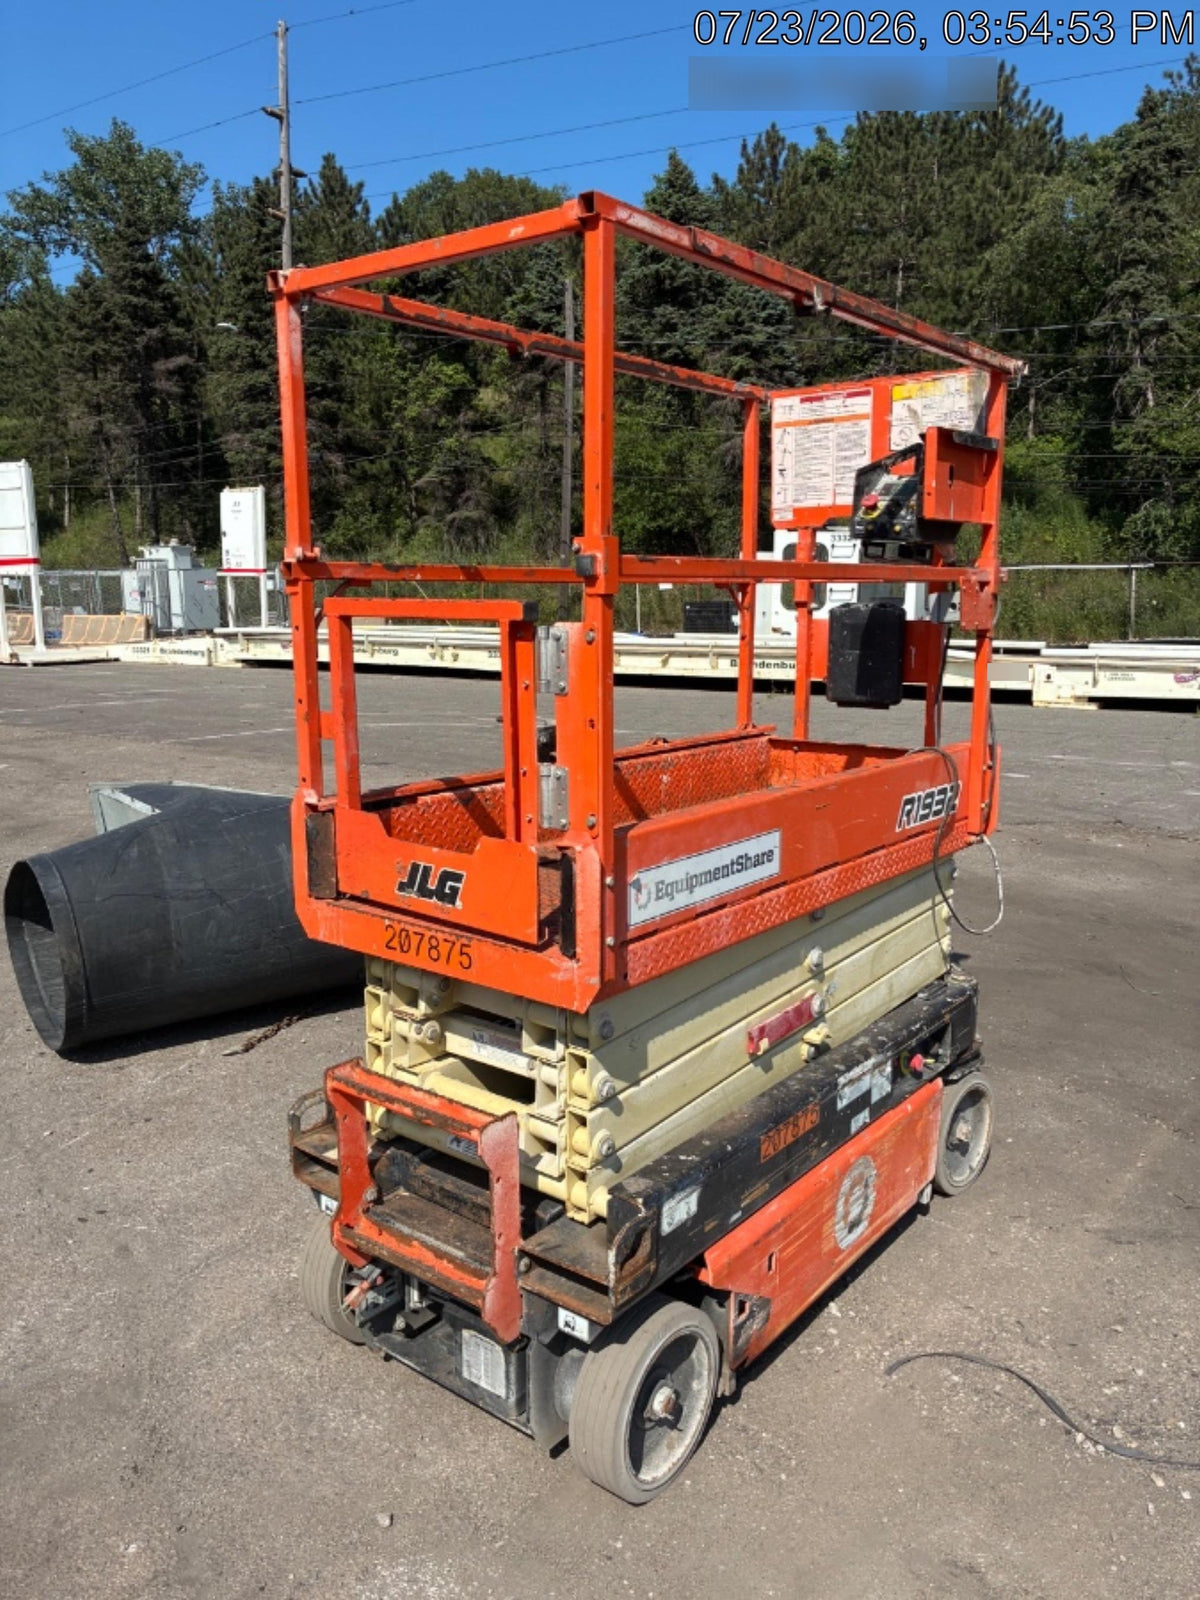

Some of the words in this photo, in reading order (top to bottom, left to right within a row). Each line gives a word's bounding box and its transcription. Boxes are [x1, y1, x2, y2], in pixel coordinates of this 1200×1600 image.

[396, 860, 466, 908] JLG
[655, 849, 774, 902] EquipmentShare
[385, 924, 472, 969] 207875
[761, 1103, 819, 1160] 207875
